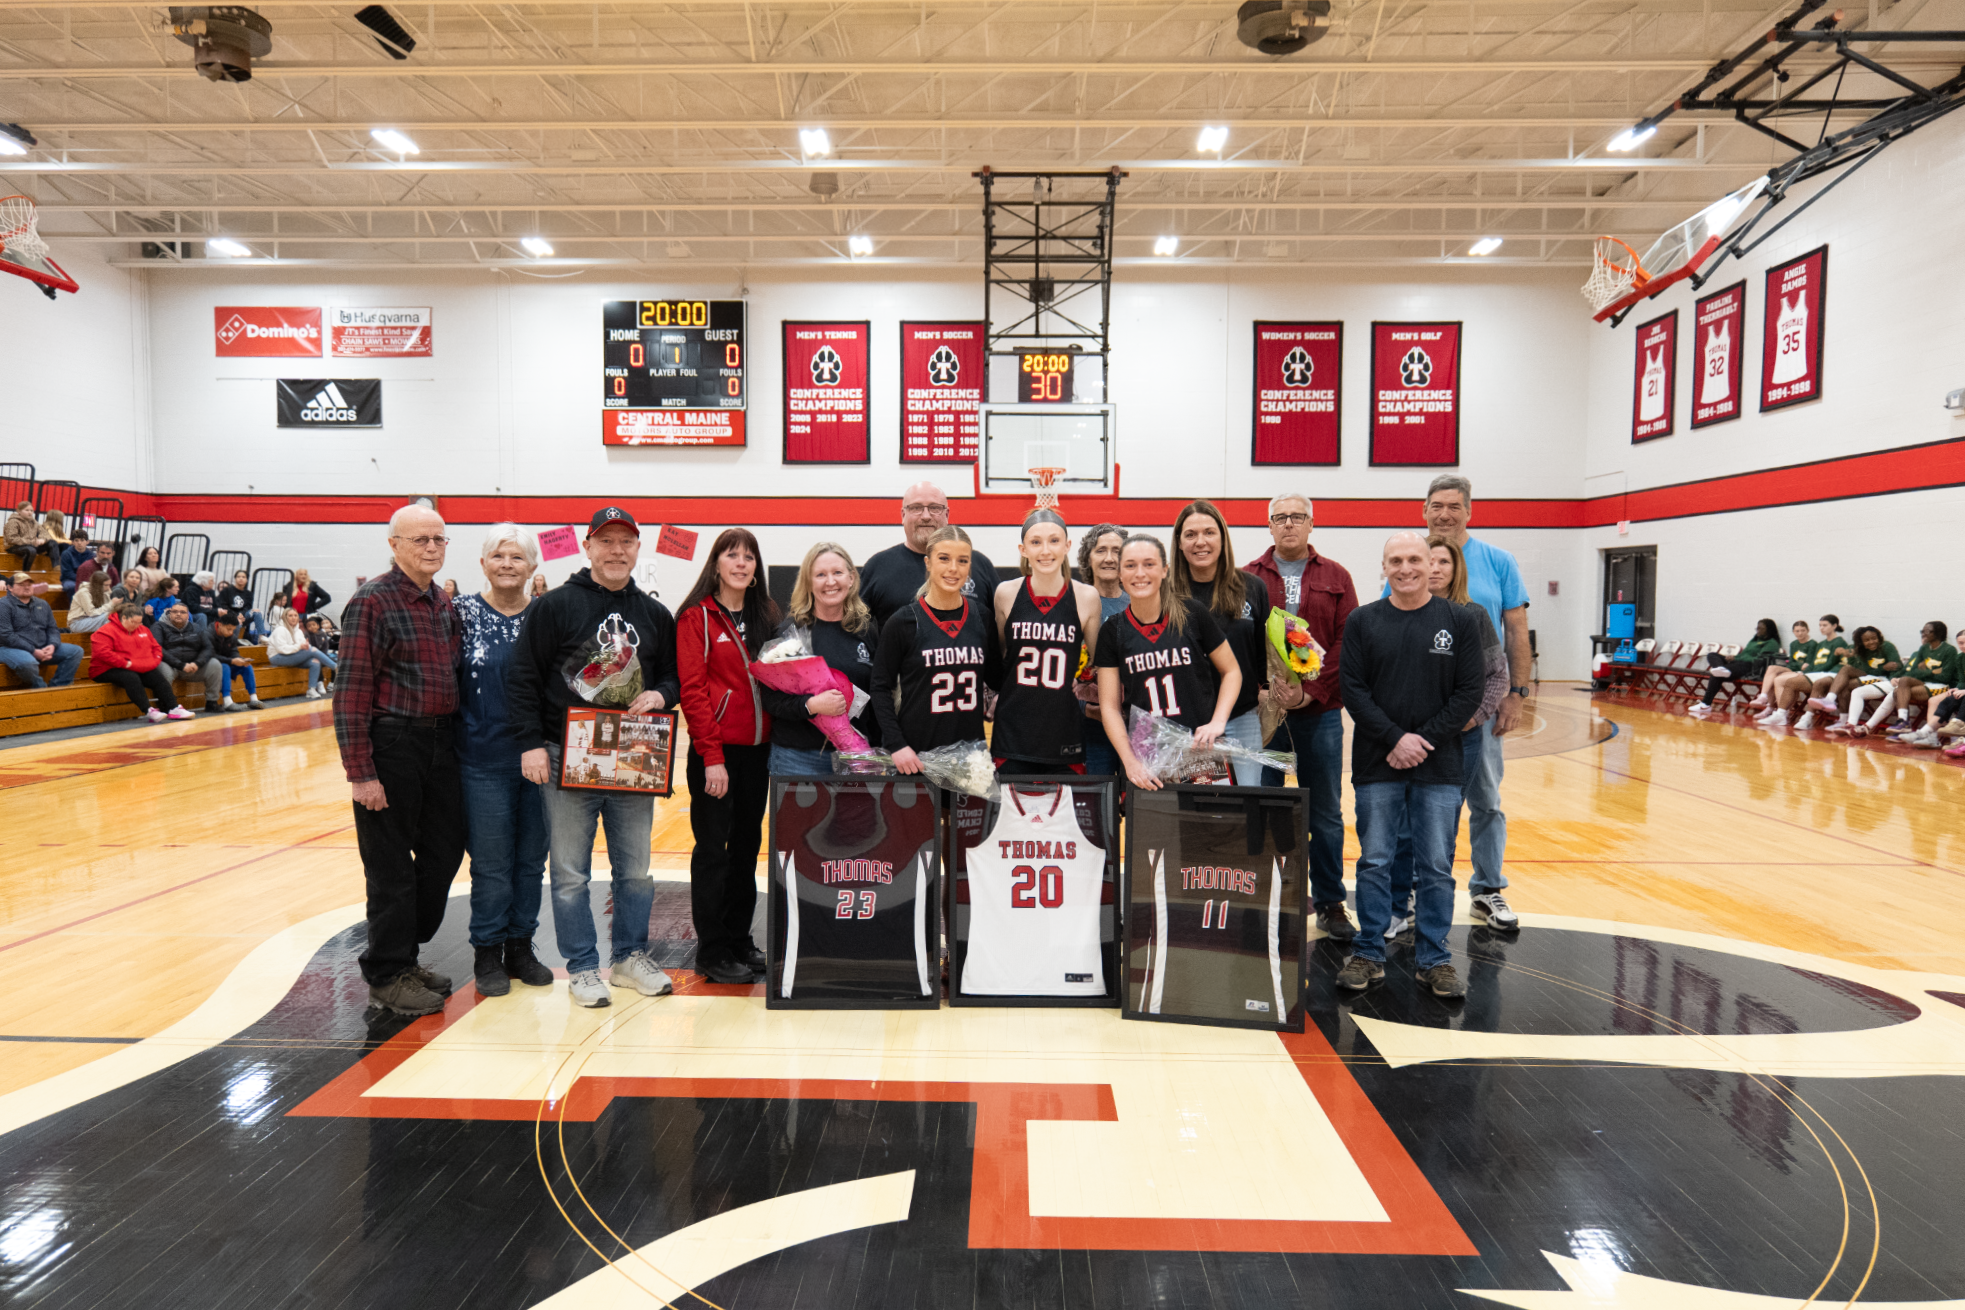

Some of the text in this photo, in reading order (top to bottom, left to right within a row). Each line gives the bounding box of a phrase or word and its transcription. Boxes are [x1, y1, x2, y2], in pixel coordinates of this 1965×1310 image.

[1783, 263, 1806, 281] ANGIE
[1781, 275, 1807, 294] RAMOS
[1706, 294, 1733, 313] PAULINE
[354, 312, 419, 325] Husqvarna
[641, 302, 706, 325] 20:00
[246, 324, 318, 338] Domino's
[1782, 318, 1803, 332] THOMAS
[610, 330, 640, 341] HOME
[661, 335, 686, 343] PERIOD
[705, 330, 738, 341] GUEST
[796, 331, 857, 339] MEN'S TENNIS
[914, 331, 973, 339] MEN'S SOCCER
[1262, 332, 1335, 340] WOMEN'S SOCCER
[1392, 332, 1442, 340] MEN'S GOLF
[1782, 331, 1800, 355] 35
[630, 343, 643, 367] 0
[674, 346, 680, 364] 1
[726, 343, 740, 367] 0
[1709, 344, 1727, 357] THOMAS
[1023, 354, 1069, 372] 20:00
[1709, 356, 1724, 377] 32
[605, 369, 628, 377] FOULS
[650, 369, 698, 377] PLAYER FOUL
[720, 369, 742, 377] FOULS
[614, 377, 626, 396] 0
[727, 377, 739, 396] 0
[1031, 372, 1061, 400] 30
[1648, 378, 1658, 397] 21
[1767, 380, 1810, 402] 1994-1998
[790, 388, 863, 398] CONFERENCE
[907, 388, 980, 399] CONFERENCE
[1260, 390, 1334, 400] CONFERENCE
[1378, 390, 1452, 400] CONFERENCE
[606, 398, 629, 406] SCORE
[661, 398, 686, 406] MATCH
[720, 398, 742, 406] SCORE
[790, 400, 863, 410] CHAMPIONS
[907, 400, 979, 410] CHAMPIONS
[1260, 401, 1334, 411] CHAMPIONS
[1378, 401, 1452, 412] CHAMPIONS
[301, 406, 357, 421] adidas
[618, 412, 730, 425] CENTRAL MAINE
[842, 414, 863, 422] 2023
[1404, 416, 1425, 424] 2001
[666, 427, 691, 435] AUTO
[694, 427, 727, 435] GROUP
[790, 425, 811, 434] 2024
[933, 448, 954, 456] 2010
[540, 531, 556, 539] EMILY
[1011, 621, 1076, 643] THOMAS
[921, 646, 984, 667] THOMAS
[1125, 647, 1191, 675] THOMAS
[1016, 646, 1067, 690] 20
[931, 670, 978, 714] 23
[1144, 673, 1181, 717] 11
[998, 840, 1077, 860] THOMAS
[821, 858, 893, 885] THOMAS
[1011, 865, 1064, 909] 20
[1181, 866, 1257, 895] THOMAS
[835, 889, 876, 920] 23
[1202, 899, 1229, 930] 11
